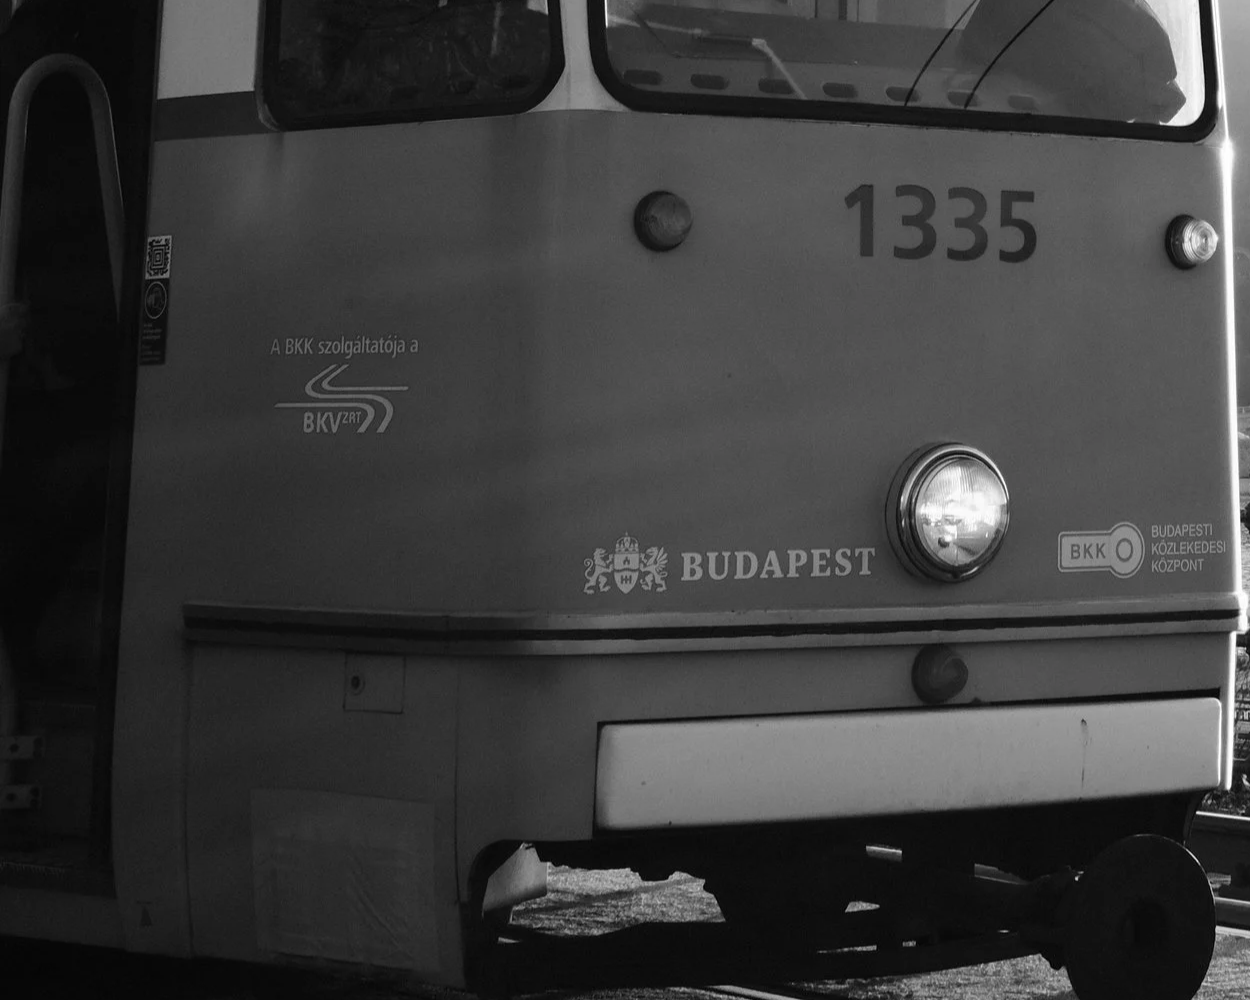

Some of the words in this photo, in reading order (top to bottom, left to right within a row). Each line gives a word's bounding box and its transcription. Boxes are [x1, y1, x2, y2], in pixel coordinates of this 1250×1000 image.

[844, 184, 1038, 264] 1335
[270, 338, 281, 355] A
[285, 337, 314, 355] BKK
[318, 335, 406, 359] szolgáltatója
[410, 339, 419, 353] a
[1151, 524, 1213, 538] BUDAPESTI
[1070, 542, 1107, 561] BKK
[680, 547, 876, 582] BUDAPEST
[1151, 556, 1204, 573] KÖZPONT
